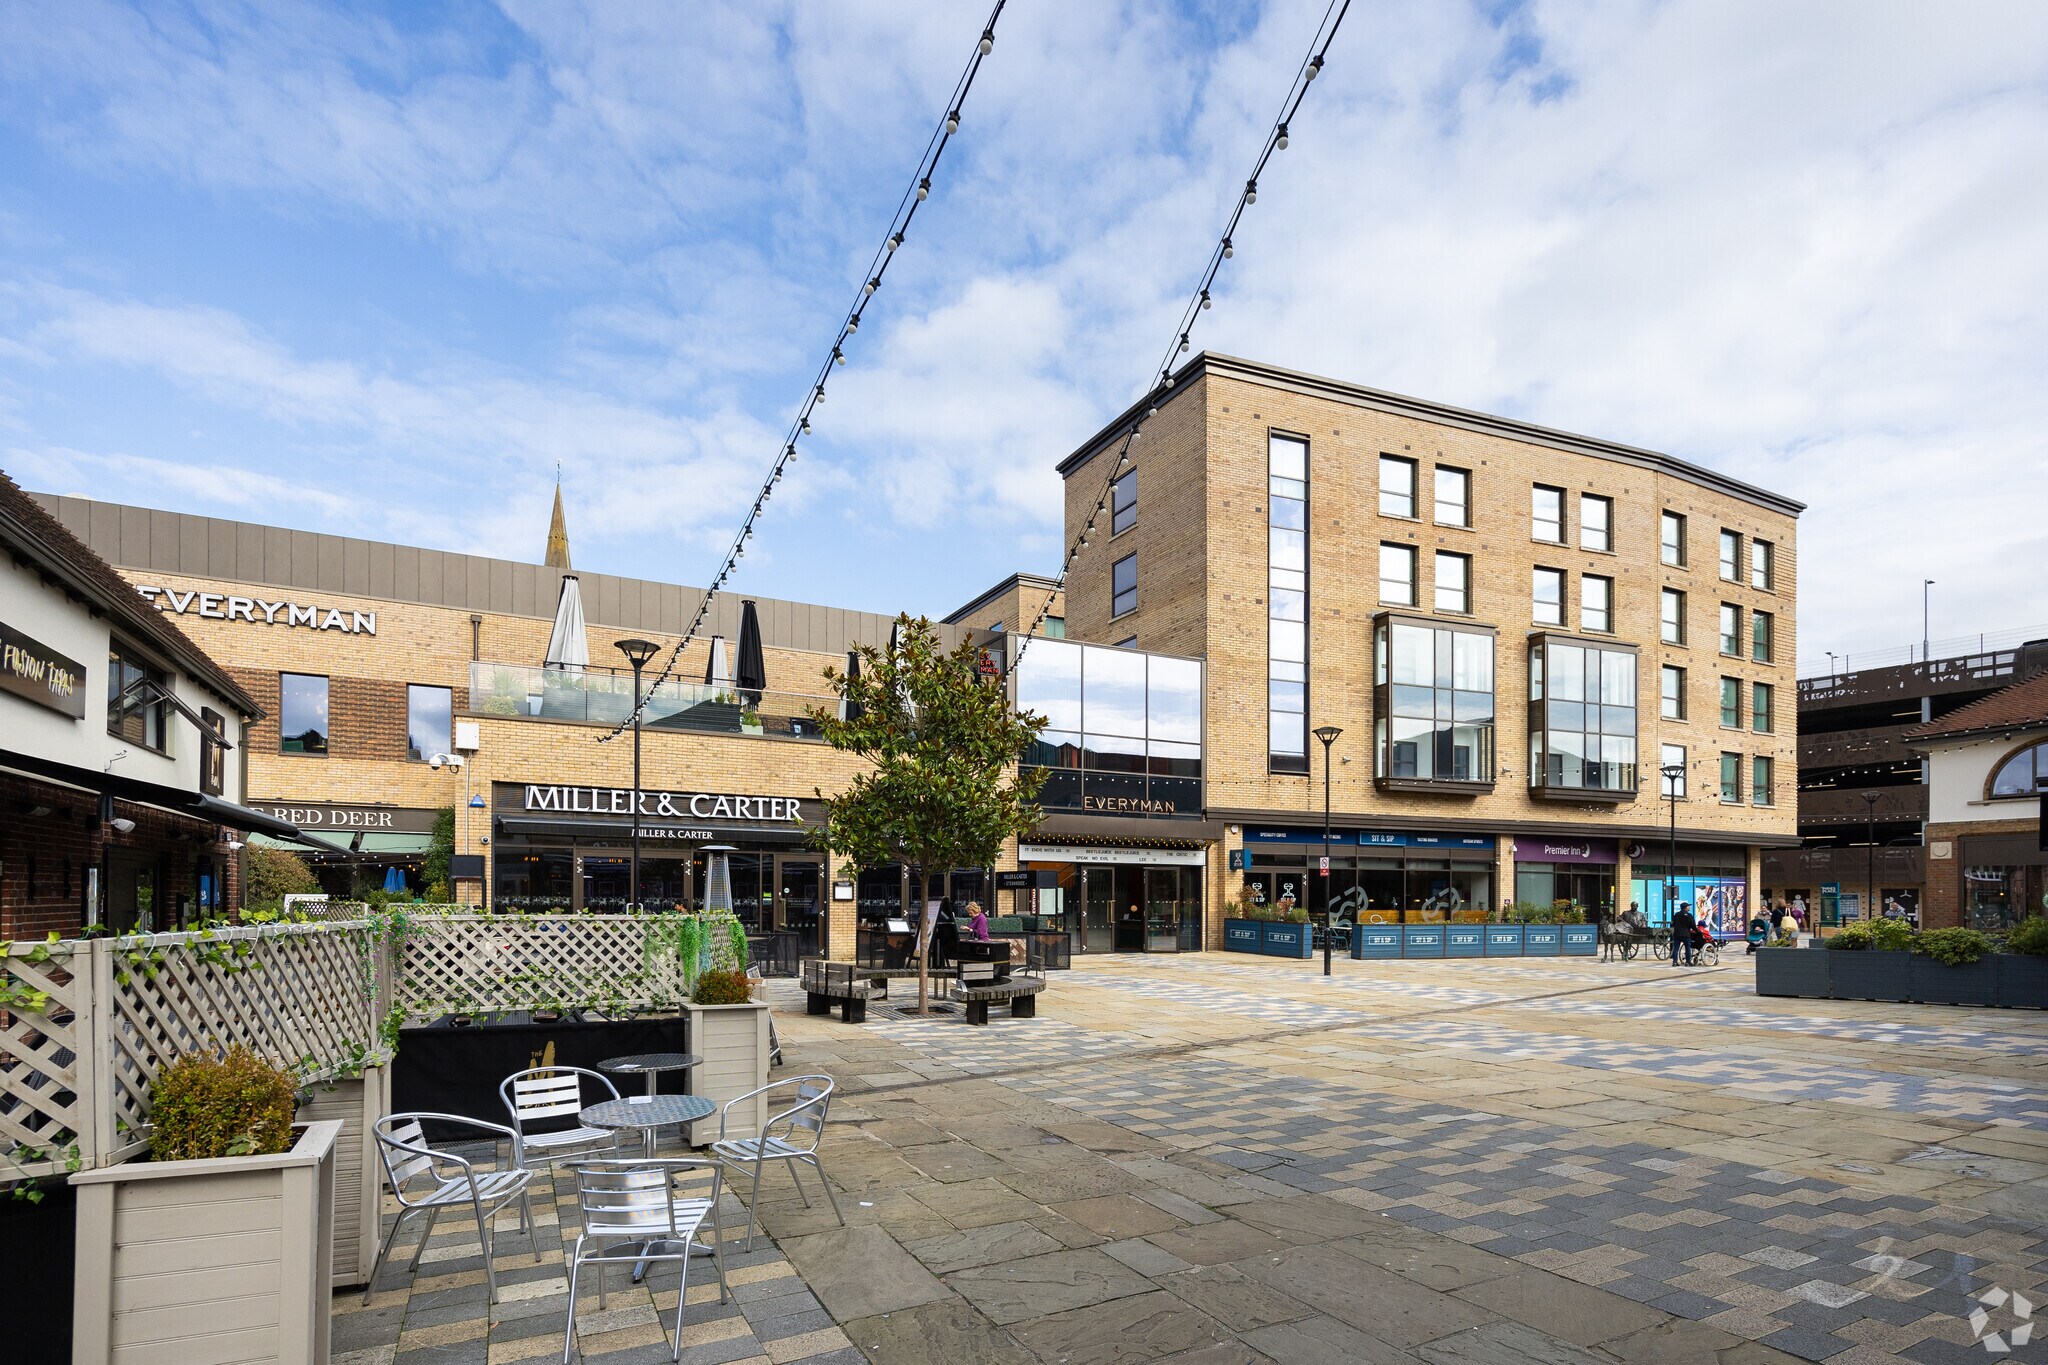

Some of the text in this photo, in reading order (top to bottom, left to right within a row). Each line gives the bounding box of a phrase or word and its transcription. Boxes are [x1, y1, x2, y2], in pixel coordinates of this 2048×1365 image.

[136, 584, 377, 635] EVERYMAN
[4, 644, 75, 698] FUSION TAPAS
[525, 785, 804, 822] MILLER & CARTER
[1084, 796, 1175, 813] EVERYMAN
[273, 808, 323, 825] RED
[329, 810, 394, 827] DEER
[668, 830, 676, 838] &
[677, 830, 713, 840] CARTER
[1386, 835, 1395, 843] SIP
[1544, 845, 1580, 855] Premier Inn
